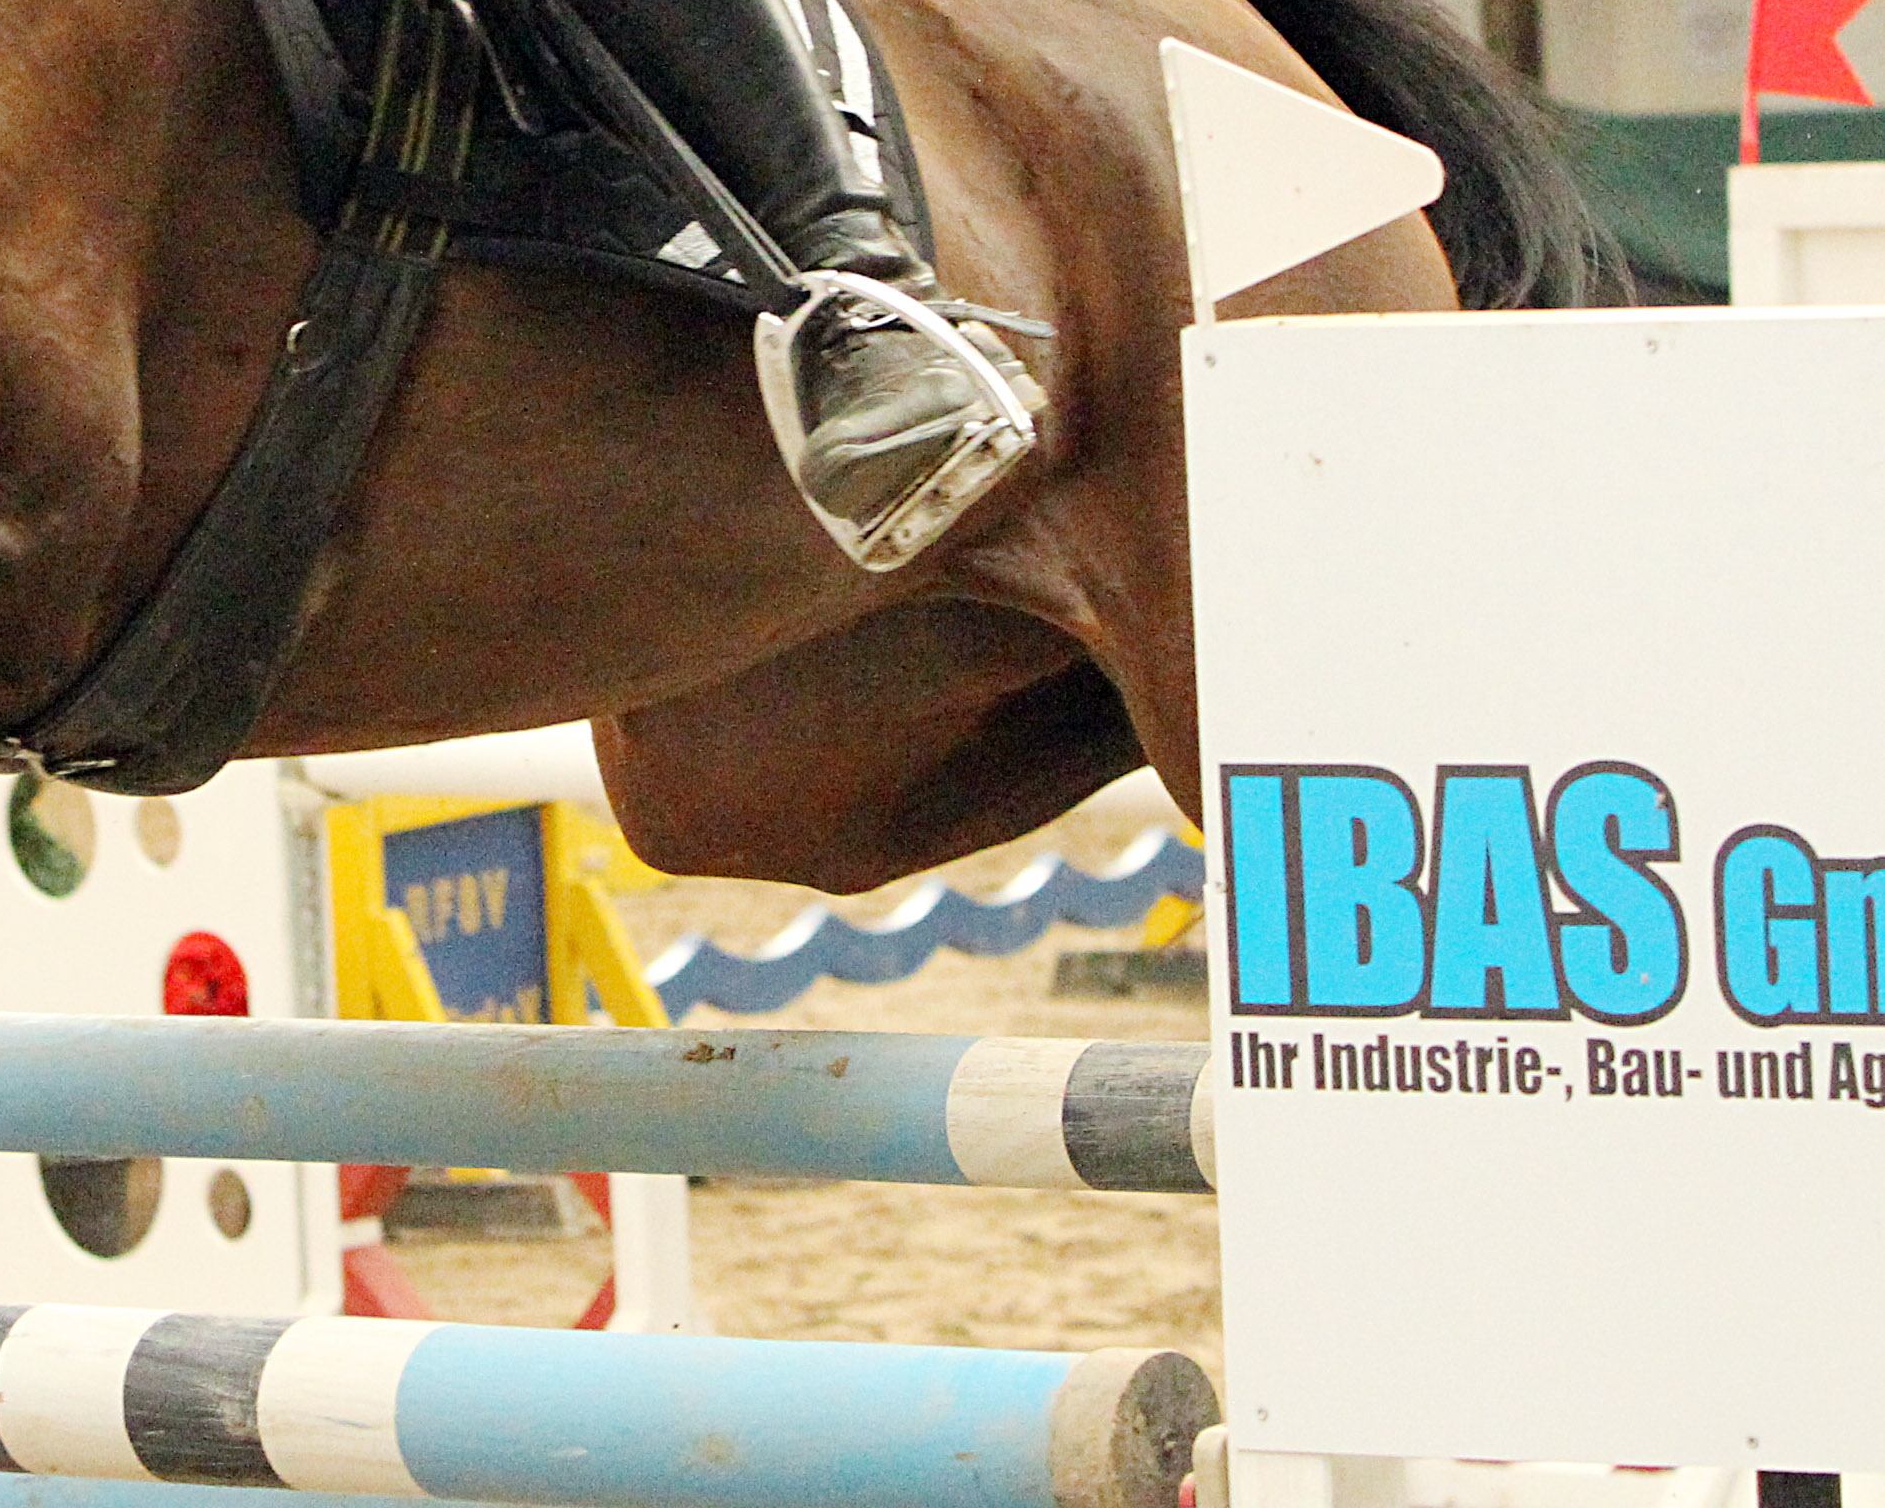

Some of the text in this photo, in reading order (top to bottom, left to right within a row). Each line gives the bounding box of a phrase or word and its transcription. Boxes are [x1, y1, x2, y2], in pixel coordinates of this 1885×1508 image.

[1219, 760, 1690, 1027] IBAS
[1230, 1031, 1299, 1089] Ihr
[1312, 1033, 1575, 1103] Industrie-,
[1586, 1038, 1702, 1097] Bau-
[1717, 1041, 1813, 1100] und
